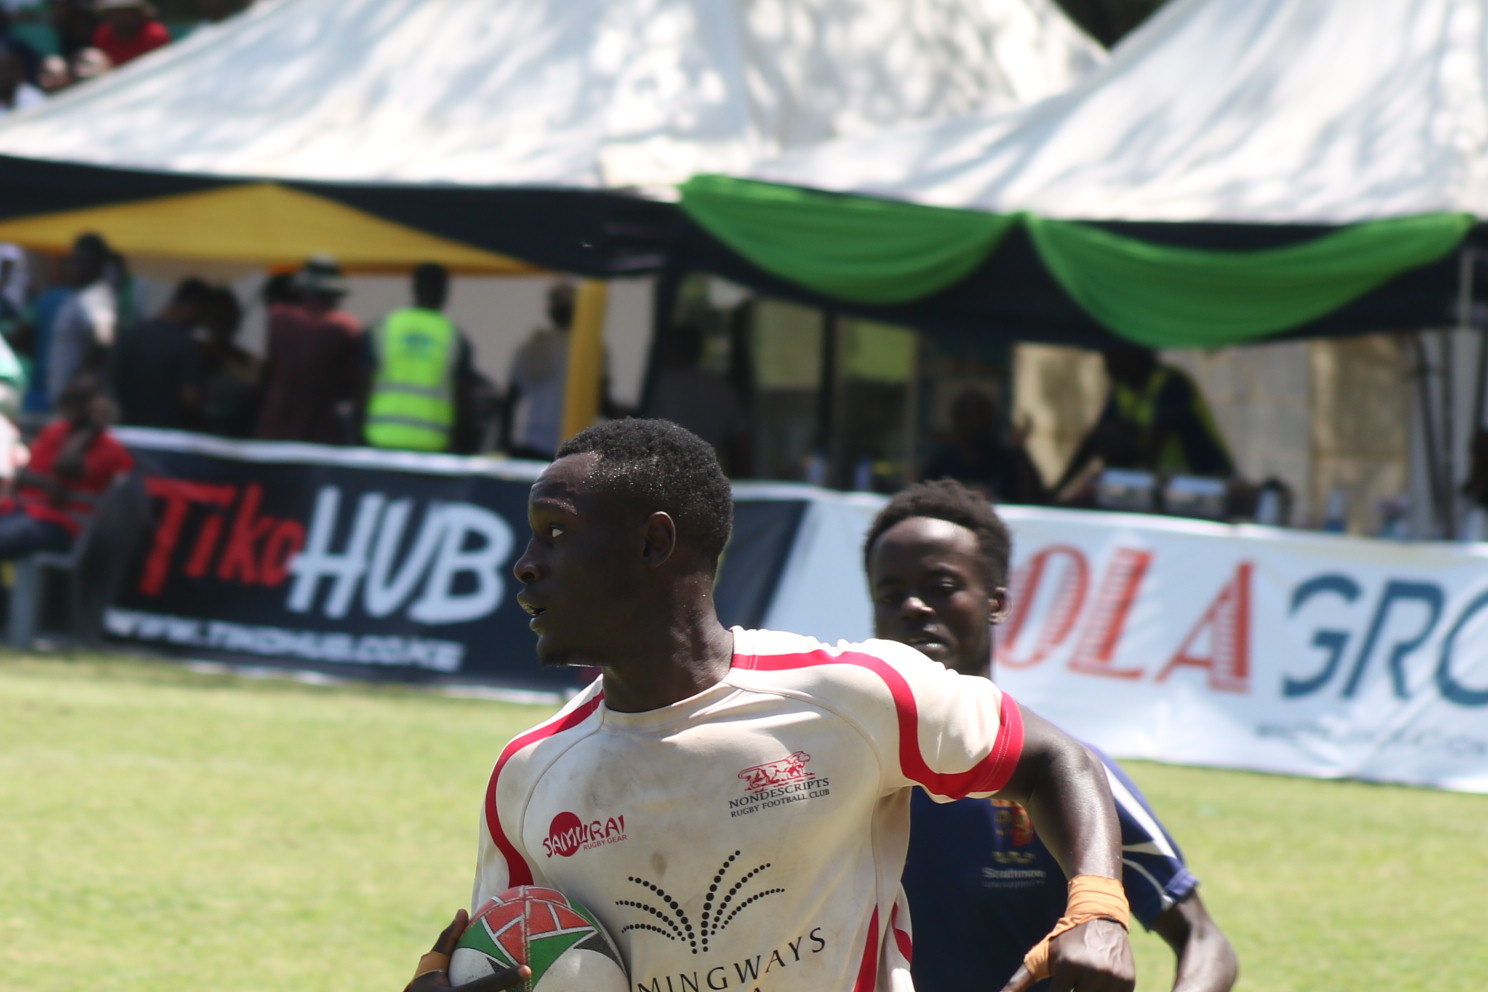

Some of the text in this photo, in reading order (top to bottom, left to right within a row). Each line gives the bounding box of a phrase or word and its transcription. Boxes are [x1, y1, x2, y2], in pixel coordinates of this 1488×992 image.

[728, 777, 830, 809] NONDESCRIPTS
[730, 788, 830, 818] RUGBY FOOTBALL CLUB
[542, 814, 625, 858] SAMURAI
[583, 834, 628, 851] RUGBY GEAR
